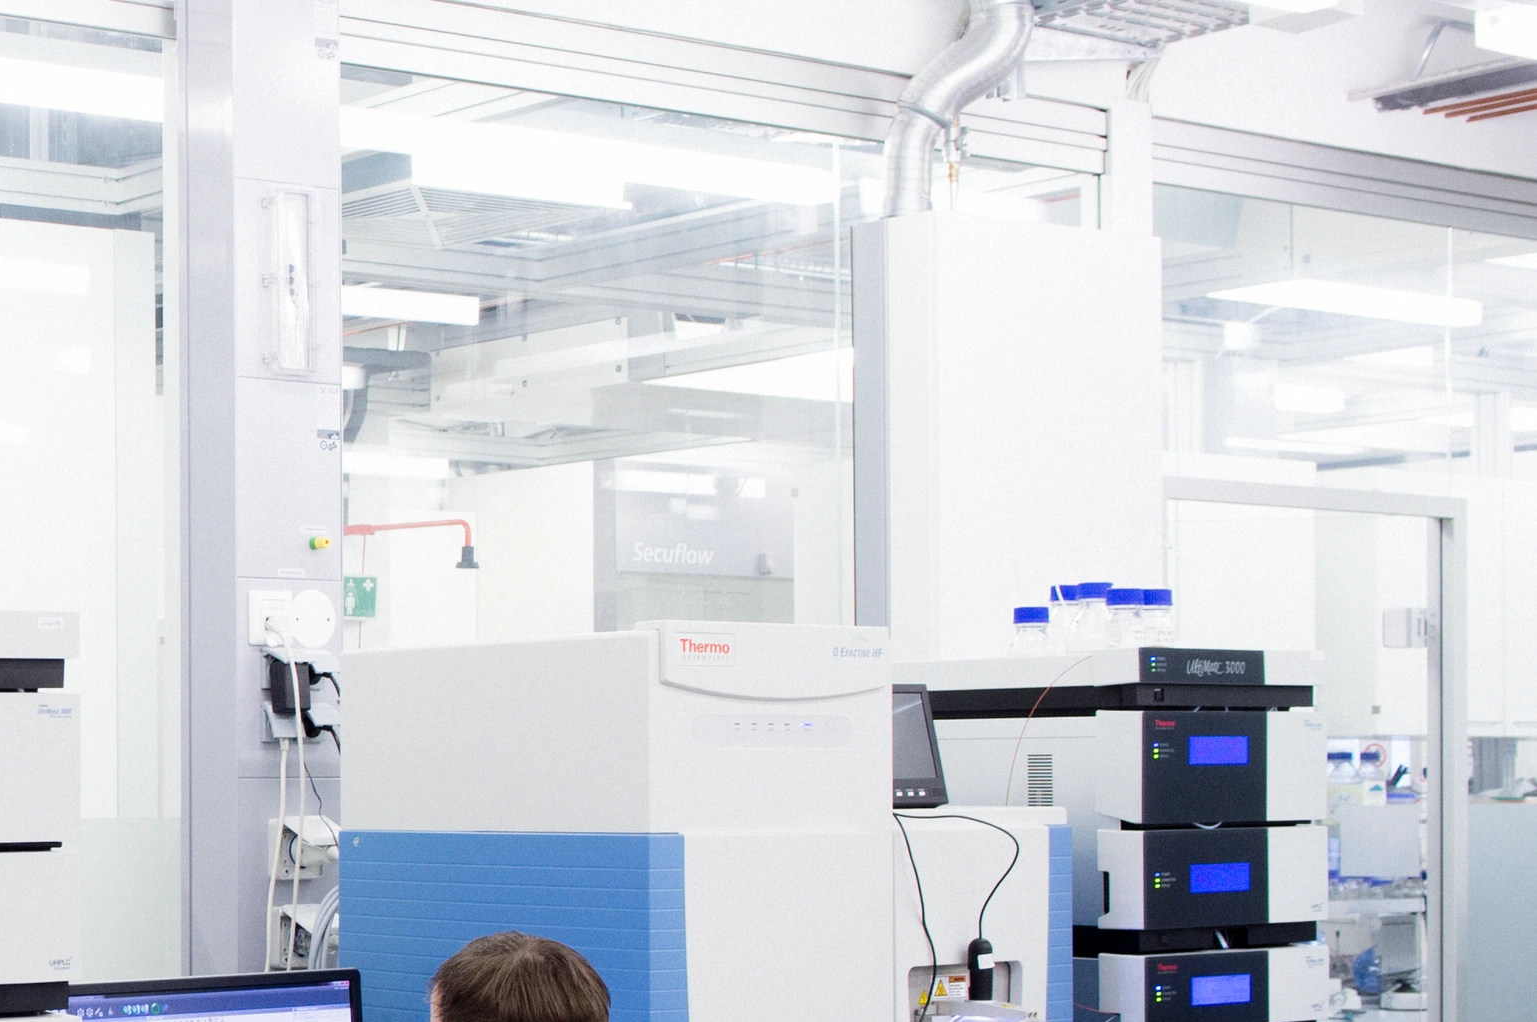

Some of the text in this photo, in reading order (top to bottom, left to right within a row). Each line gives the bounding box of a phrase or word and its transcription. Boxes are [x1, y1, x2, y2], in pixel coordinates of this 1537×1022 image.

[632, 542, 715, 566] Secuflow
[679, 638, 731, 654] Thermo
[872, 648, 883, 658] HF
[682, 654, 731, 662] SCIENTIFIC
[1186, 658, 1225, 677] UltiMate
[1225, 661, 1246, 674] 3000
